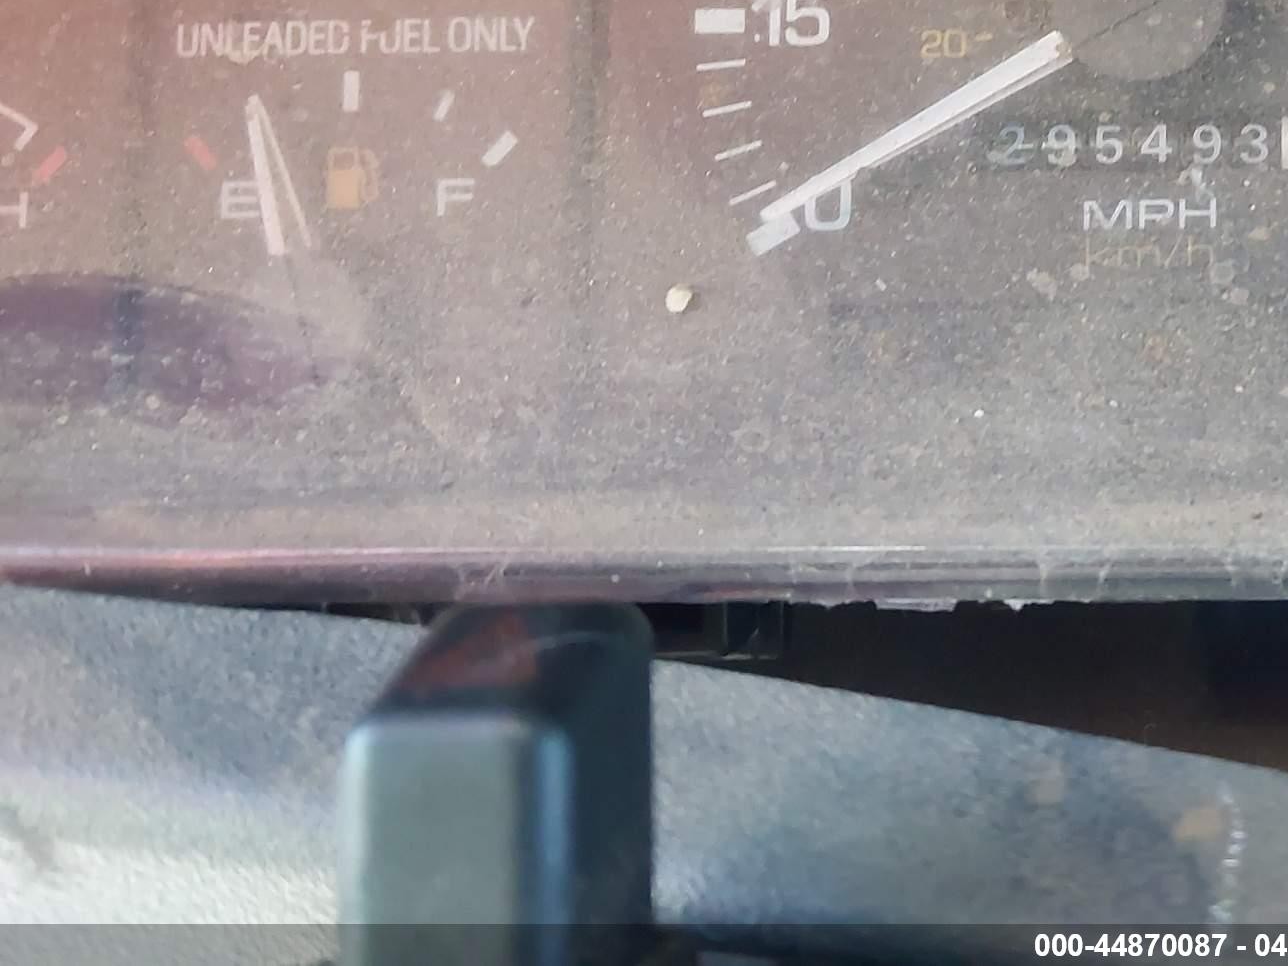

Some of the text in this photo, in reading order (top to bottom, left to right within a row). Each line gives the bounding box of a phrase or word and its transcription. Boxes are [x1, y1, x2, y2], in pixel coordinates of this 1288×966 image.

[176, 16, 535, 59] UNLEADED FUEL ONLY
[920, 30, 967, 58] 20
[221, 181, 260, 219] E
[437, 178, 476, 216] F
[805, 175, 853, 232] 0
[1083, 197, 1217, 231] MPH
[1086, 236, 1215, 270] km/h
